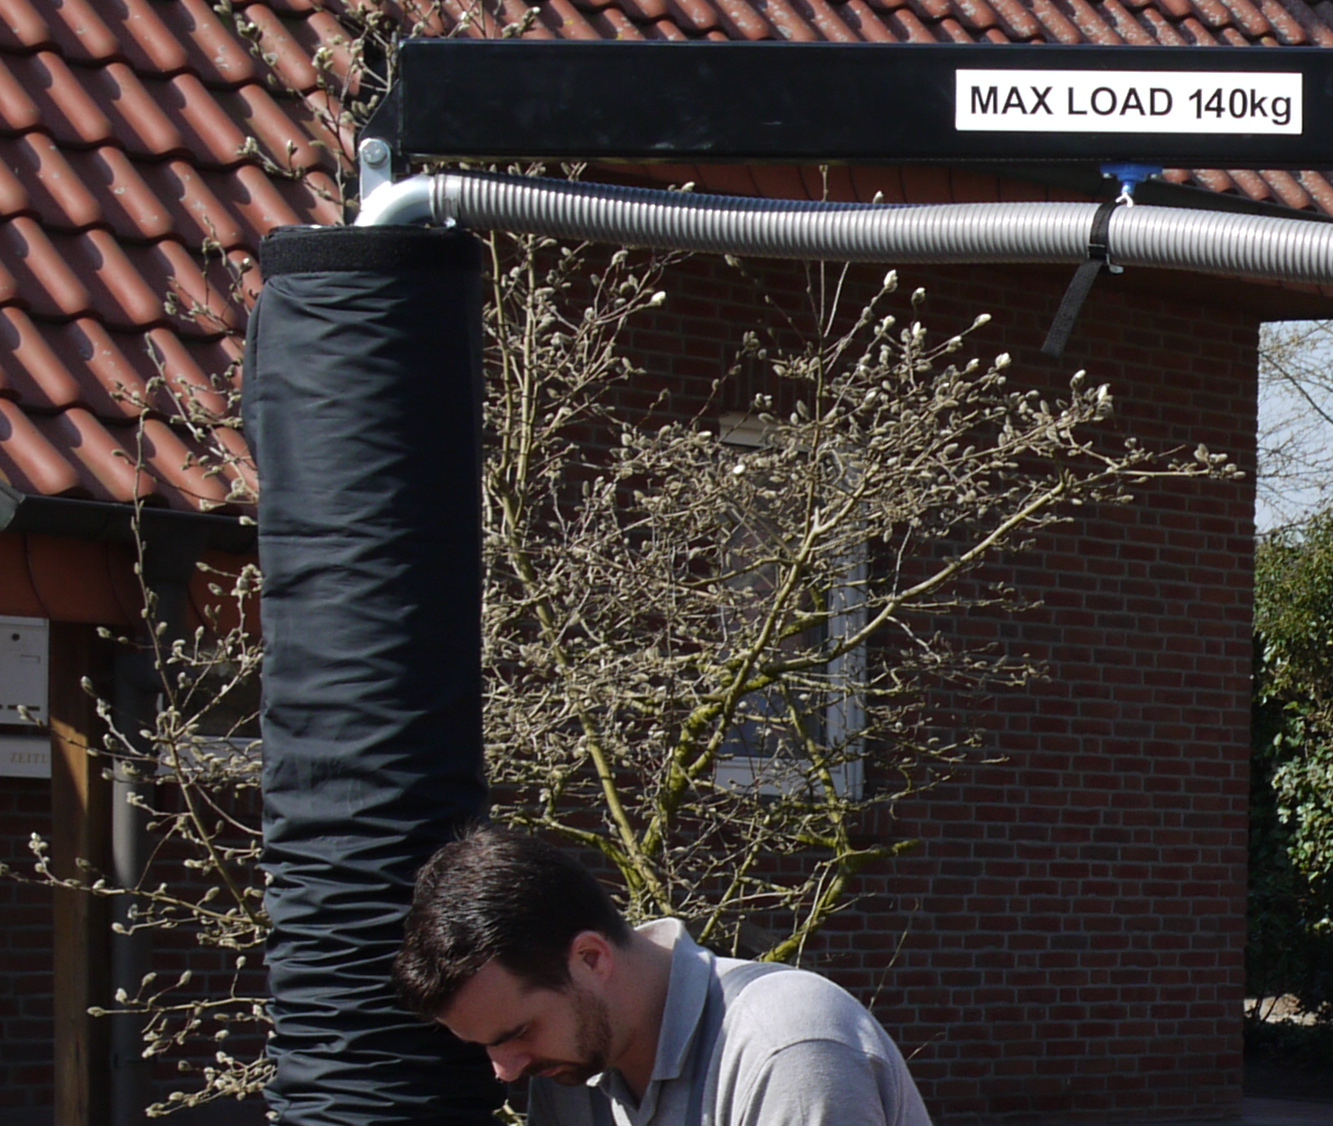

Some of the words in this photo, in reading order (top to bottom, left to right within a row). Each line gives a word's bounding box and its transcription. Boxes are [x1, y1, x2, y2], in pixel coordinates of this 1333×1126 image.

[970, 86, 1053, 116] MAX
[1067, 87, 1173, 117] LOAD
[1188, 88, 1292, 126] 140kg
[10, 751, 50, 765] ZEITU
